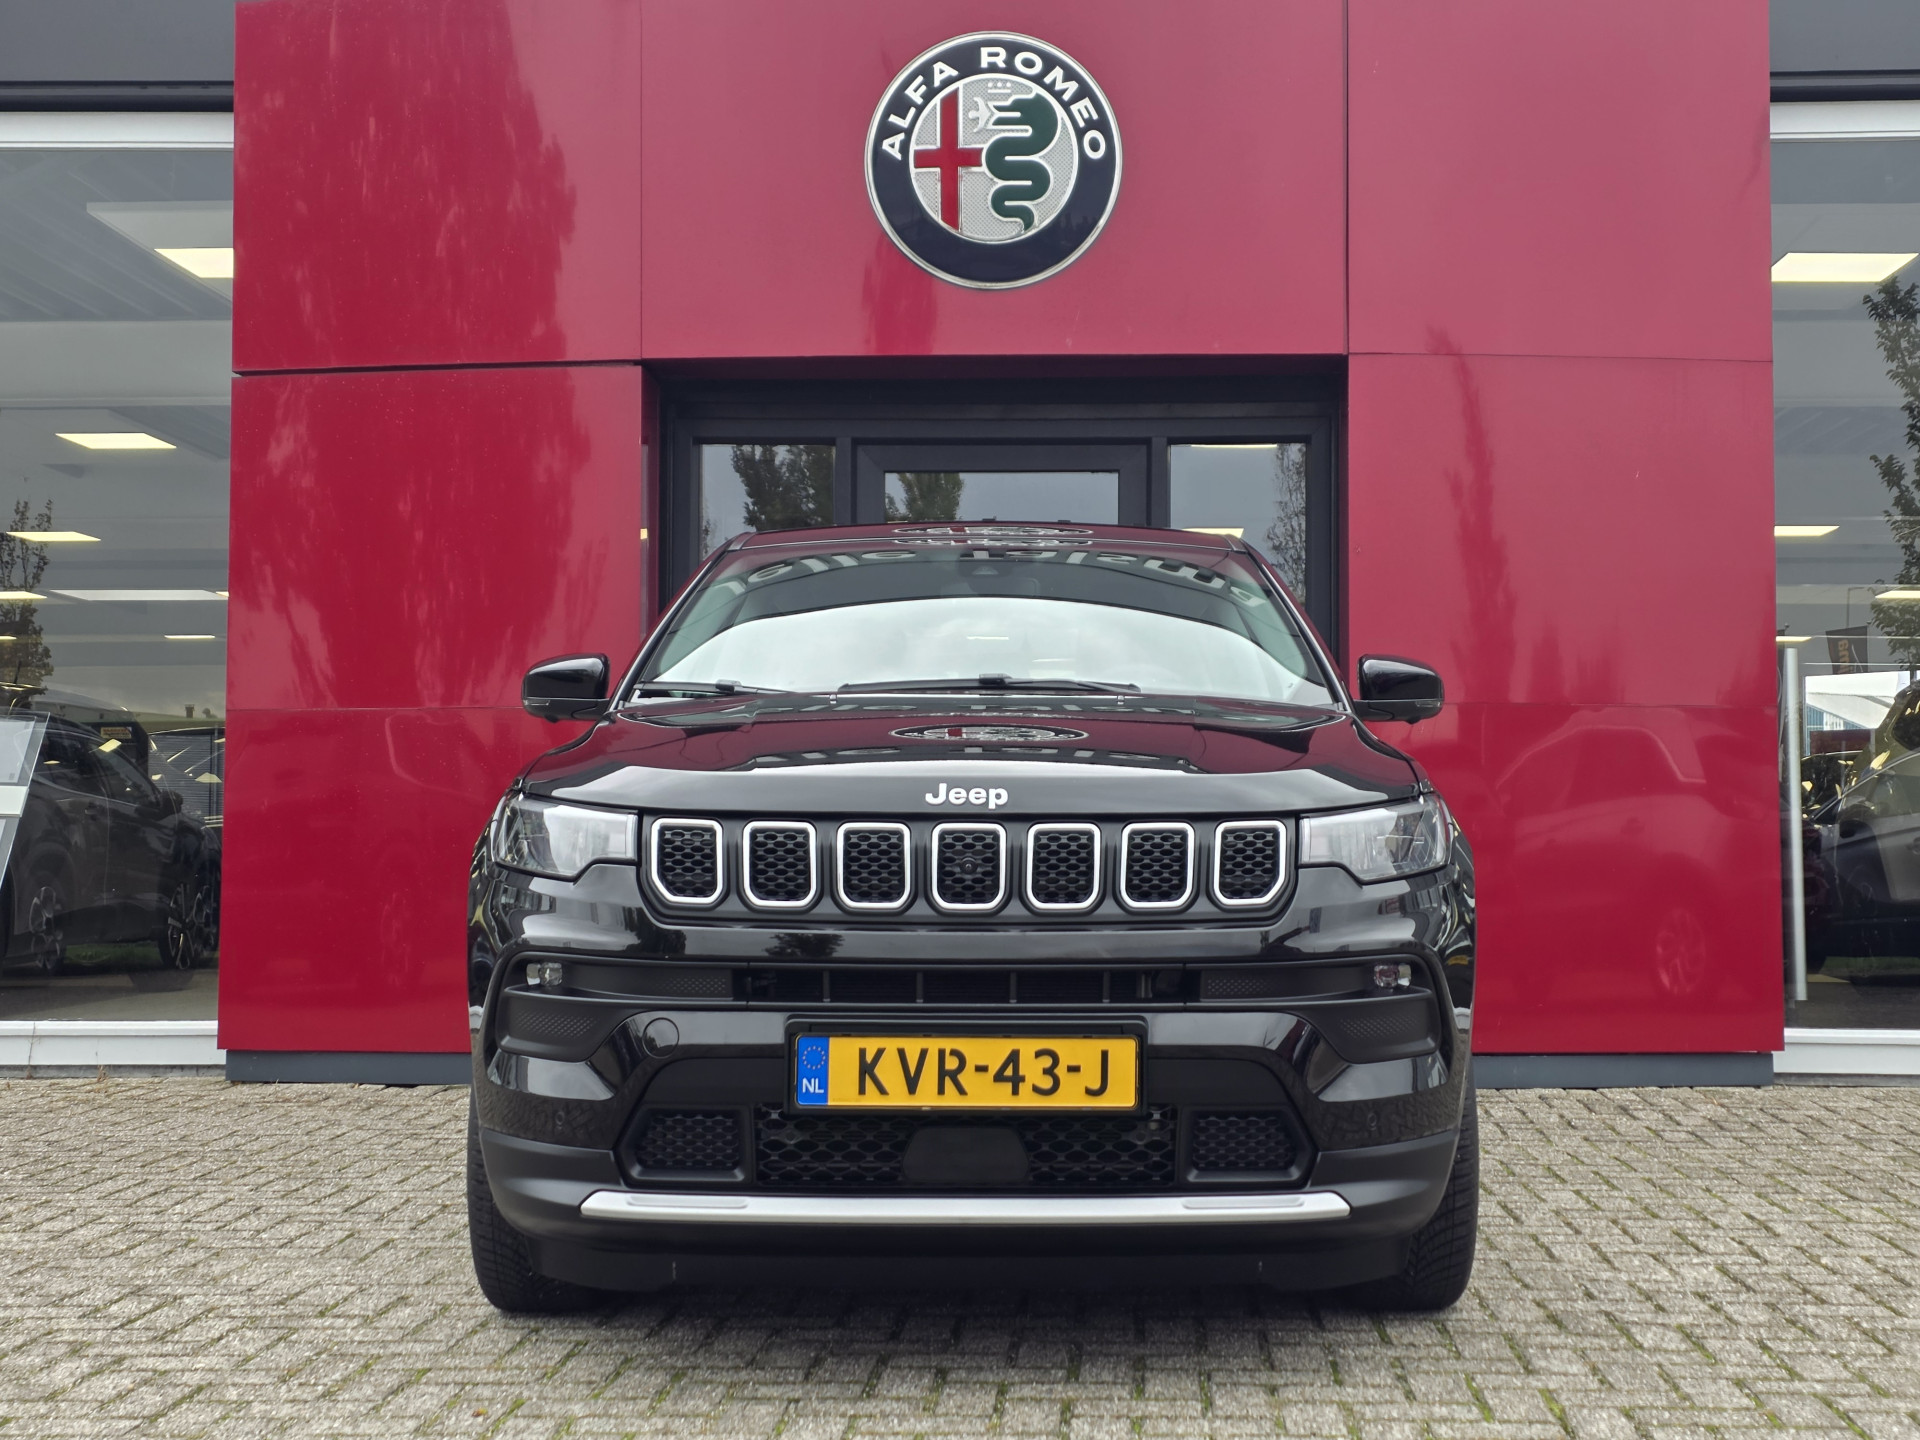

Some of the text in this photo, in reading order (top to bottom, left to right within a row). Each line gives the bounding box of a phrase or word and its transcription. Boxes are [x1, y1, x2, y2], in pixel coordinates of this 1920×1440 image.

[882, 46, 1107, 161] ALFA ROMEO
[925, 783, 1009, 809] Jeep
[802, 1077, 825, 1094] NL
[857, 1047, 1110, 1097] KVR-43-J
